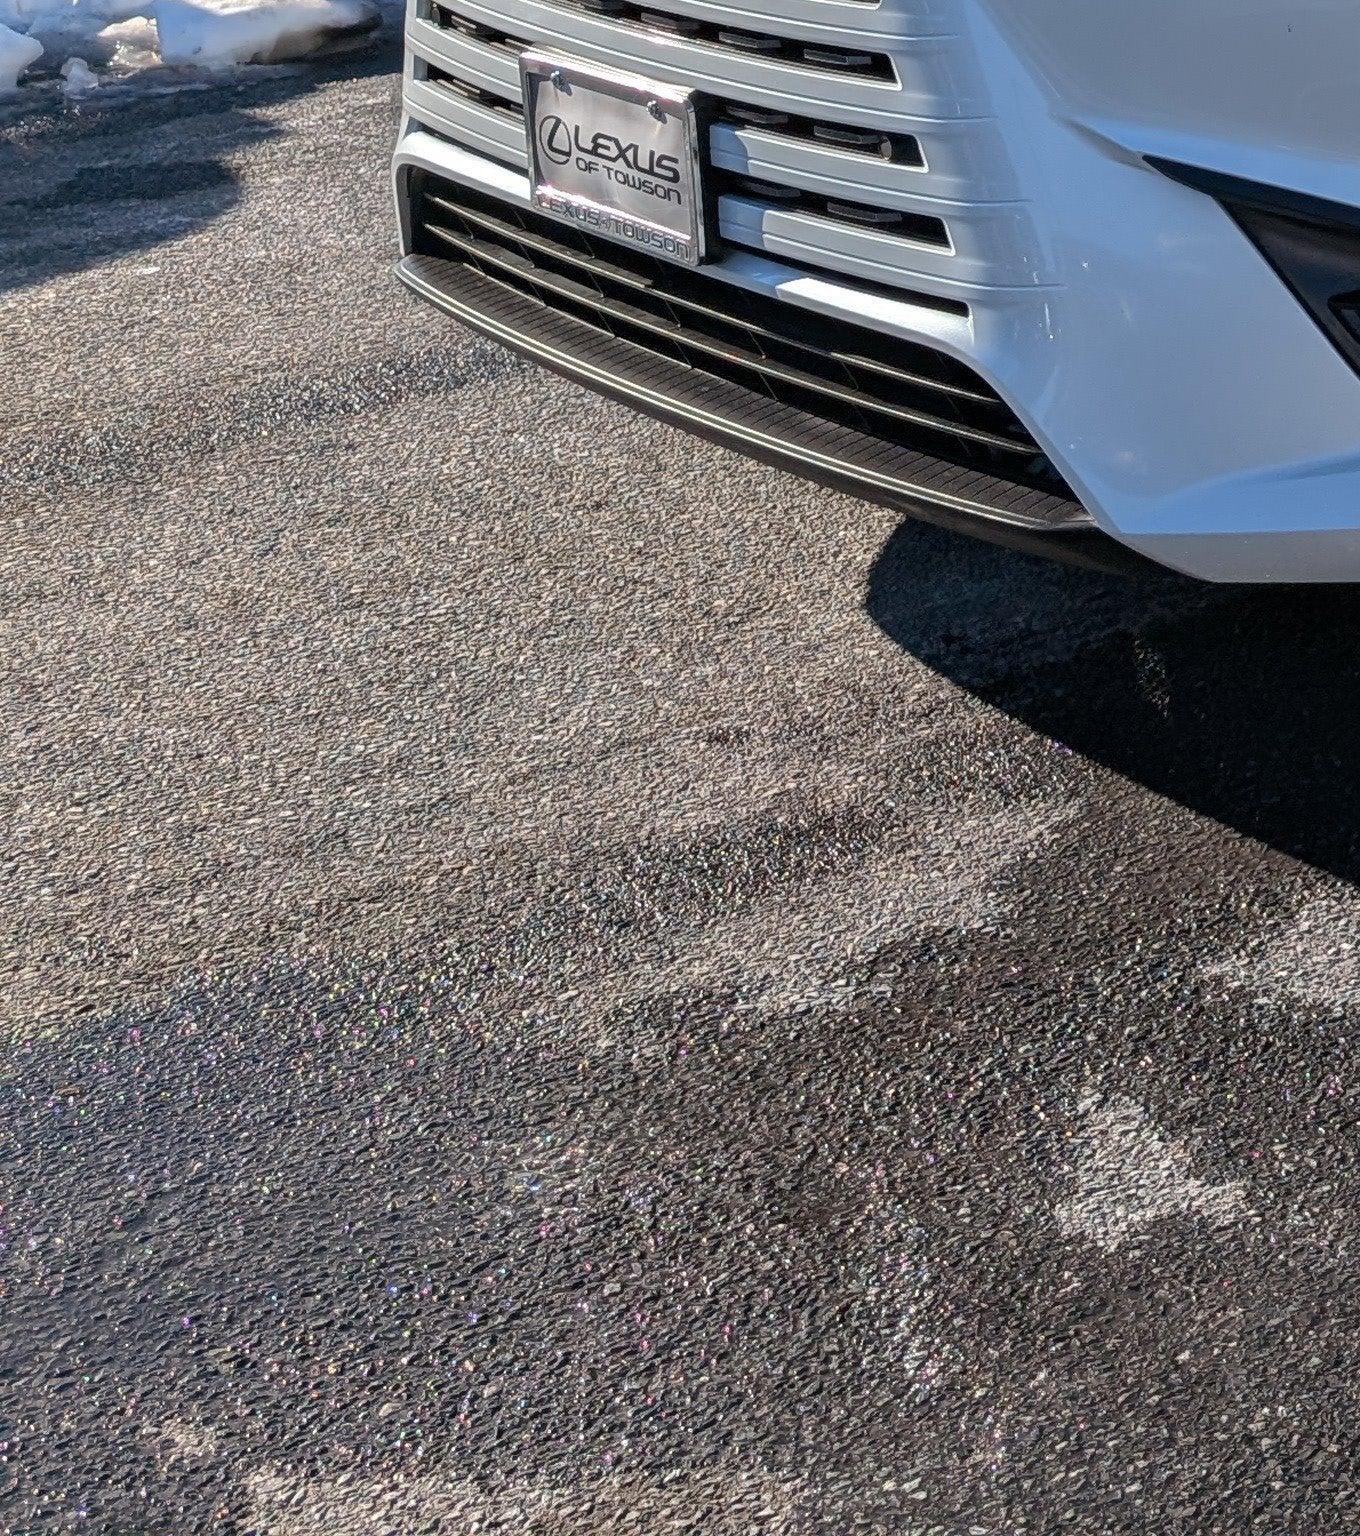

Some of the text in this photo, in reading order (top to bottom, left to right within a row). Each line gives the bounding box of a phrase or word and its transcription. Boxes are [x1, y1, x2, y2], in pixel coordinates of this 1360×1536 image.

[574, 124, 681, 184] LEXUS
[575, 157, 682, 205] OF TOWSON
[537, 195, 600, 227] LEXUS
